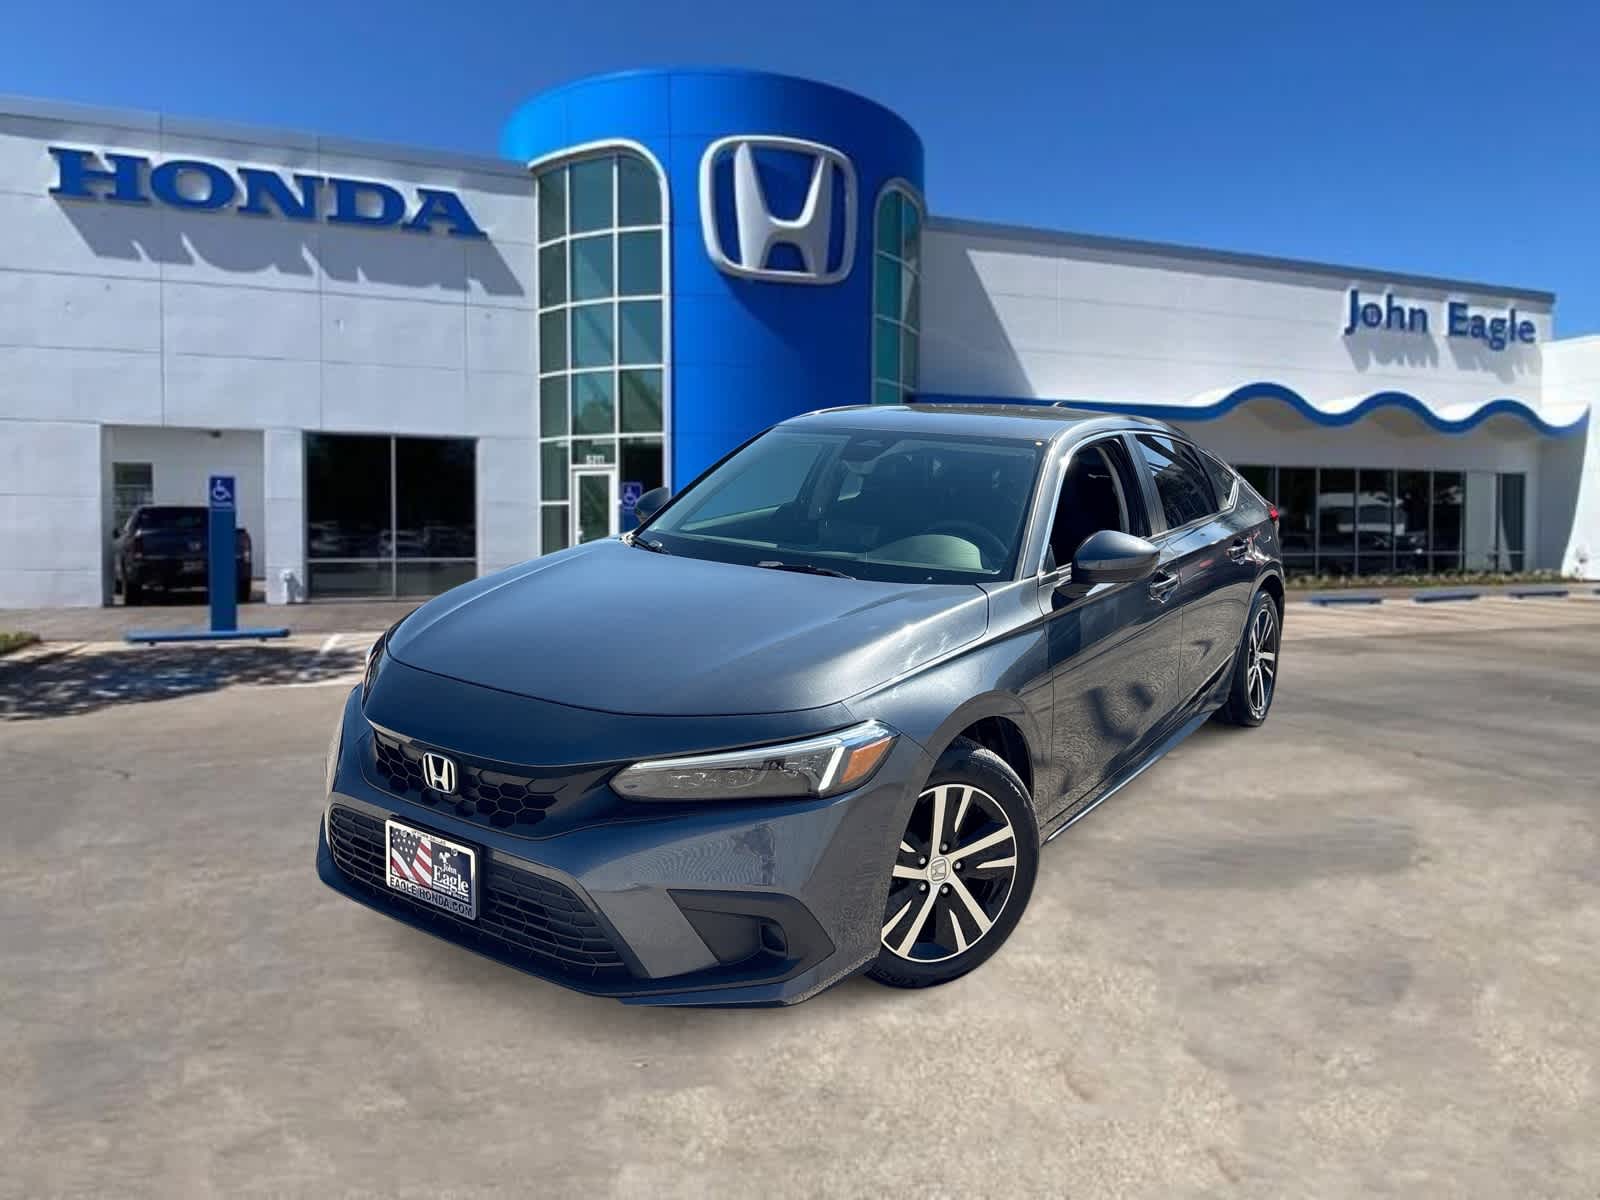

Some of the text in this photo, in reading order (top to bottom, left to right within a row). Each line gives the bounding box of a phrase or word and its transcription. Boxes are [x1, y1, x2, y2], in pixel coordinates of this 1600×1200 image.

[48, 146, 488, 240] HONDA
[1344, 289, 1537, 351] John Eagle
[433, 864, 469, 895] Eagle
